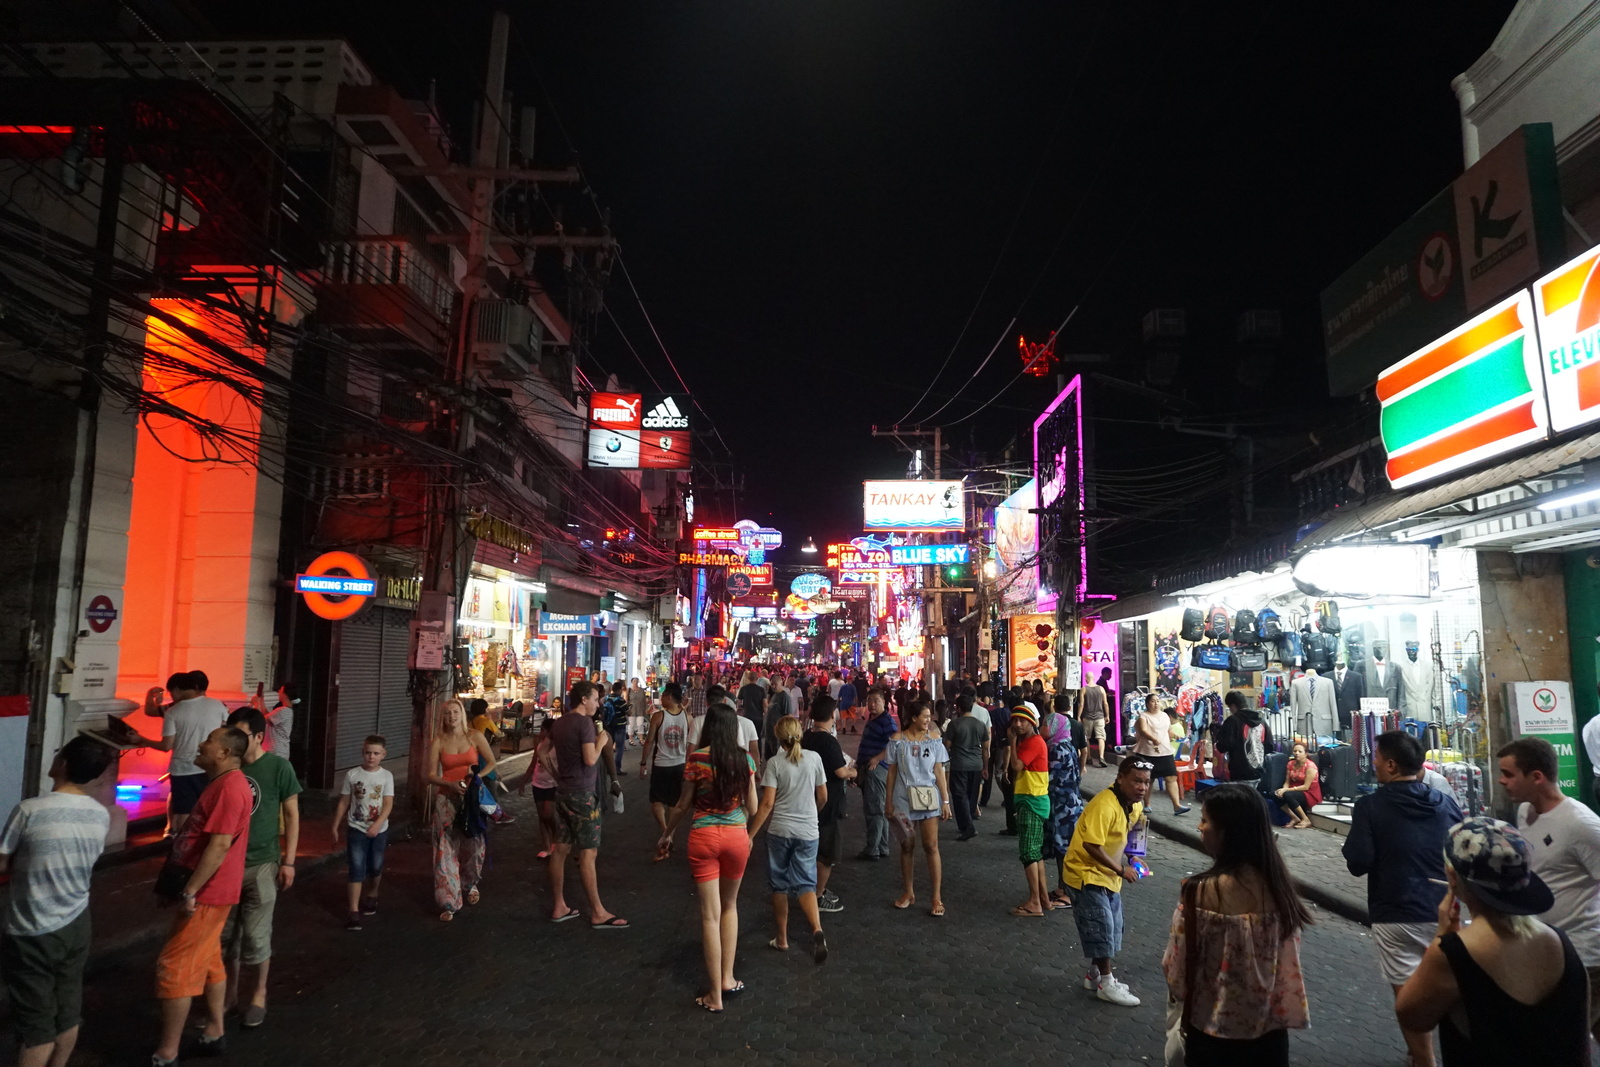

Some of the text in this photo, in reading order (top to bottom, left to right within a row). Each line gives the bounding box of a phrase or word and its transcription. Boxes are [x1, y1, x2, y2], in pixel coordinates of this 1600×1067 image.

[1470, 179, 1522, 259] K
[642, 416, 688, 428] adidas
[870, 493, 936, 506] TANKAY
[679, 553, 746, 566] PHARMACY
[841, 552, 891, 563] SEA ZON
[892, 547, 967, 563] BLUE SKY
[729, 566, 769, 575] MANDARIN
[300, 579, 341, 591] WALKING
[343, 582, 374, 592] STREET
[542, 623, 587, 631] EXCHANGE
[1553, 744, 1573, 756] TM
